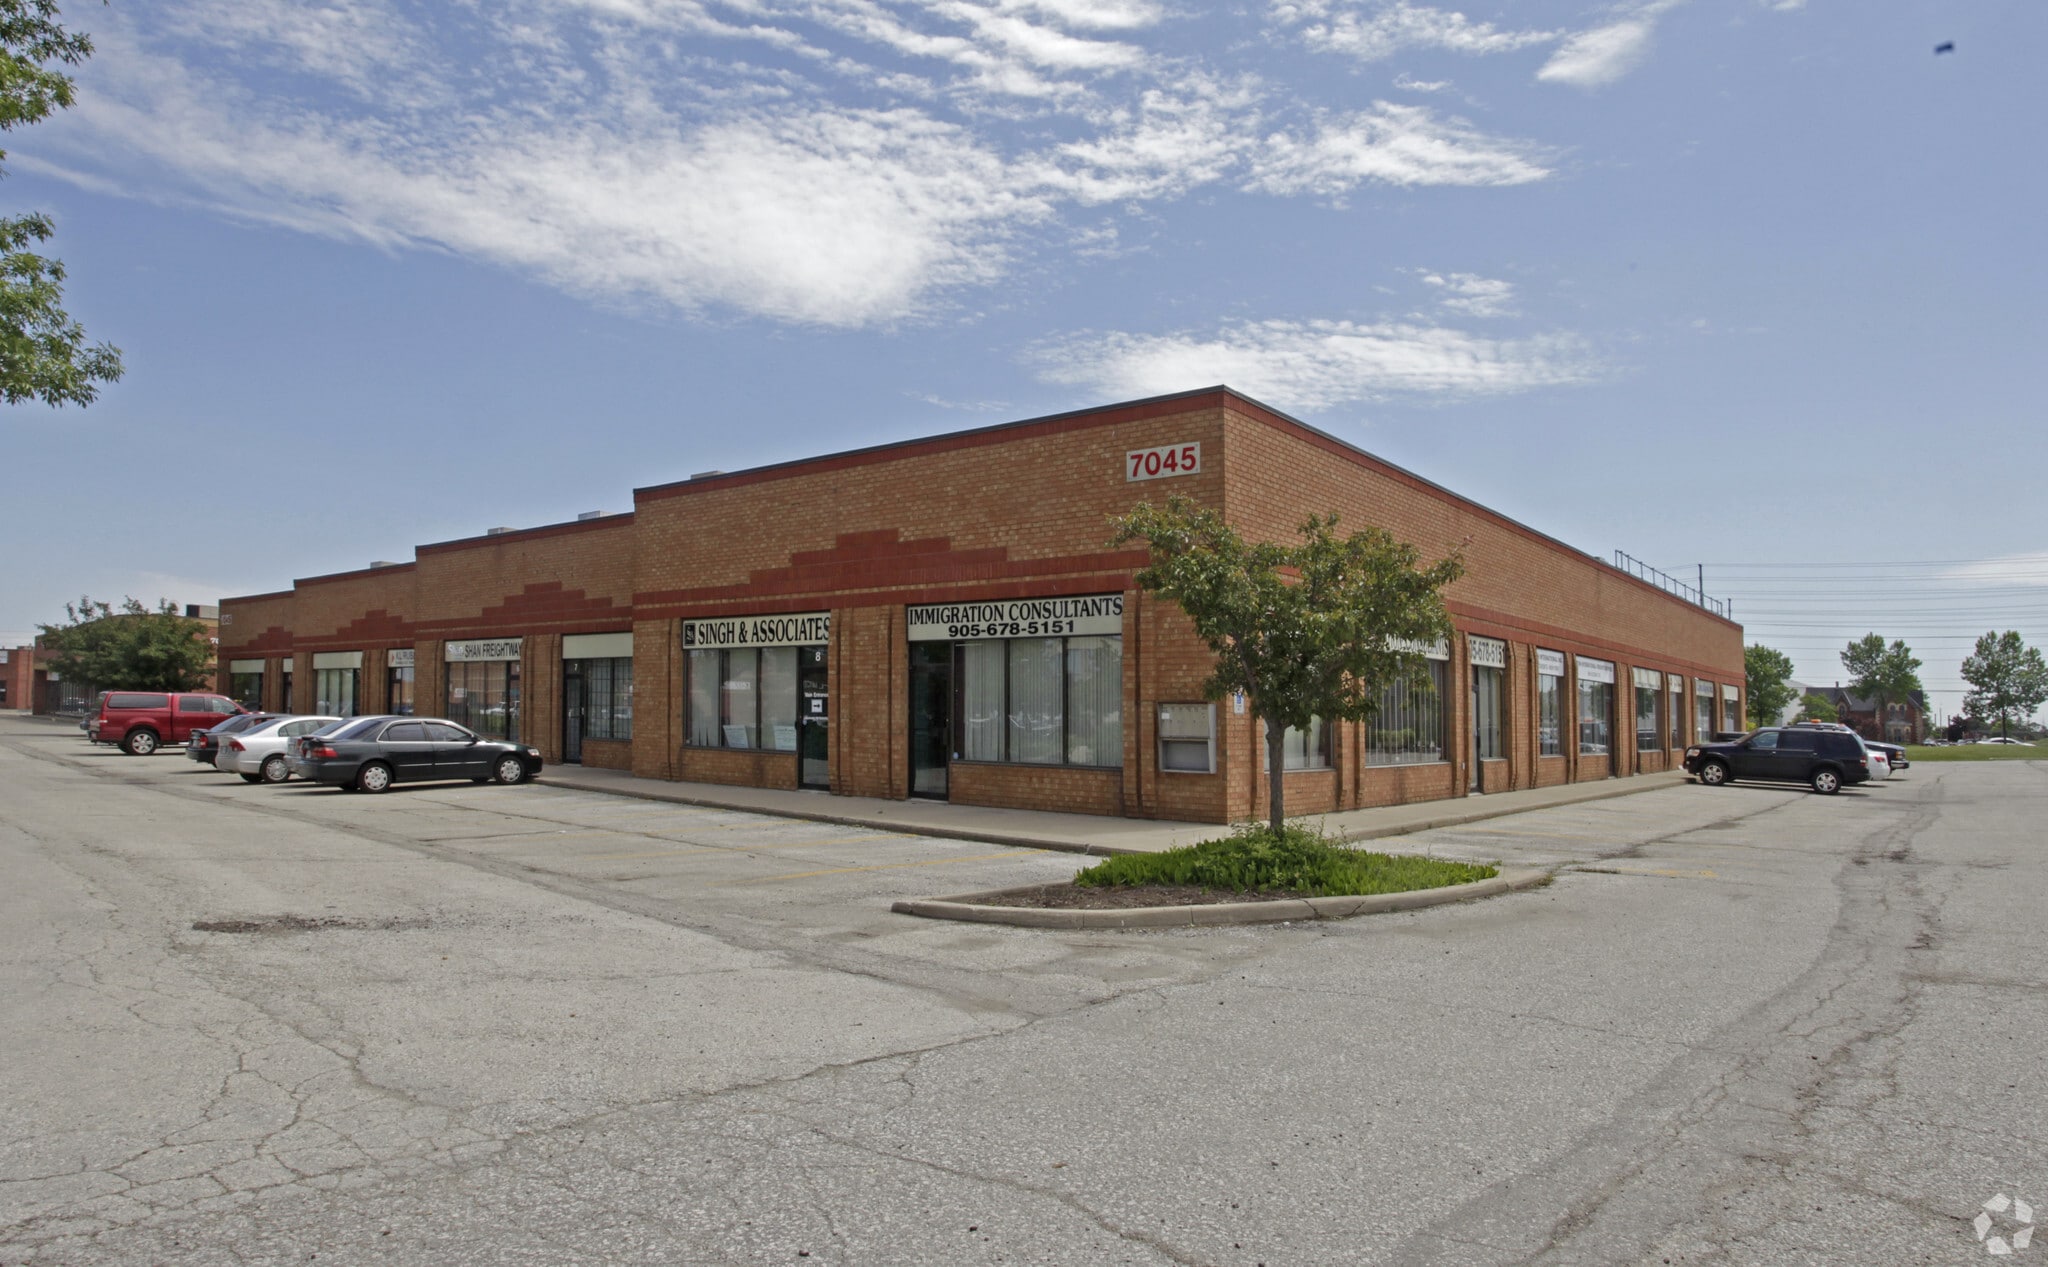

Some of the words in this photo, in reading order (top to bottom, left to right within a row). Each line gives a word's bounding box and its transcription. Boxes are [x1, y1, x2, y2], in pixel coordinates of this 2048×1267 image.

[1130, 446, 1197, 477] 7045
[909, 603, 1005, 626] IMMIGRATION
[1008, 596, 1123, 621] CONSULTANTS
[698, 622, 735, 645] SINGH
[738, 621, 748, 643] &
[751, 616, 831, 643] ASSOCIATES
[948, 620, 1075, 638] 905-678-5151
[465, 644, 481, 658] SHAN
[815, 651, 821, 662] 8
